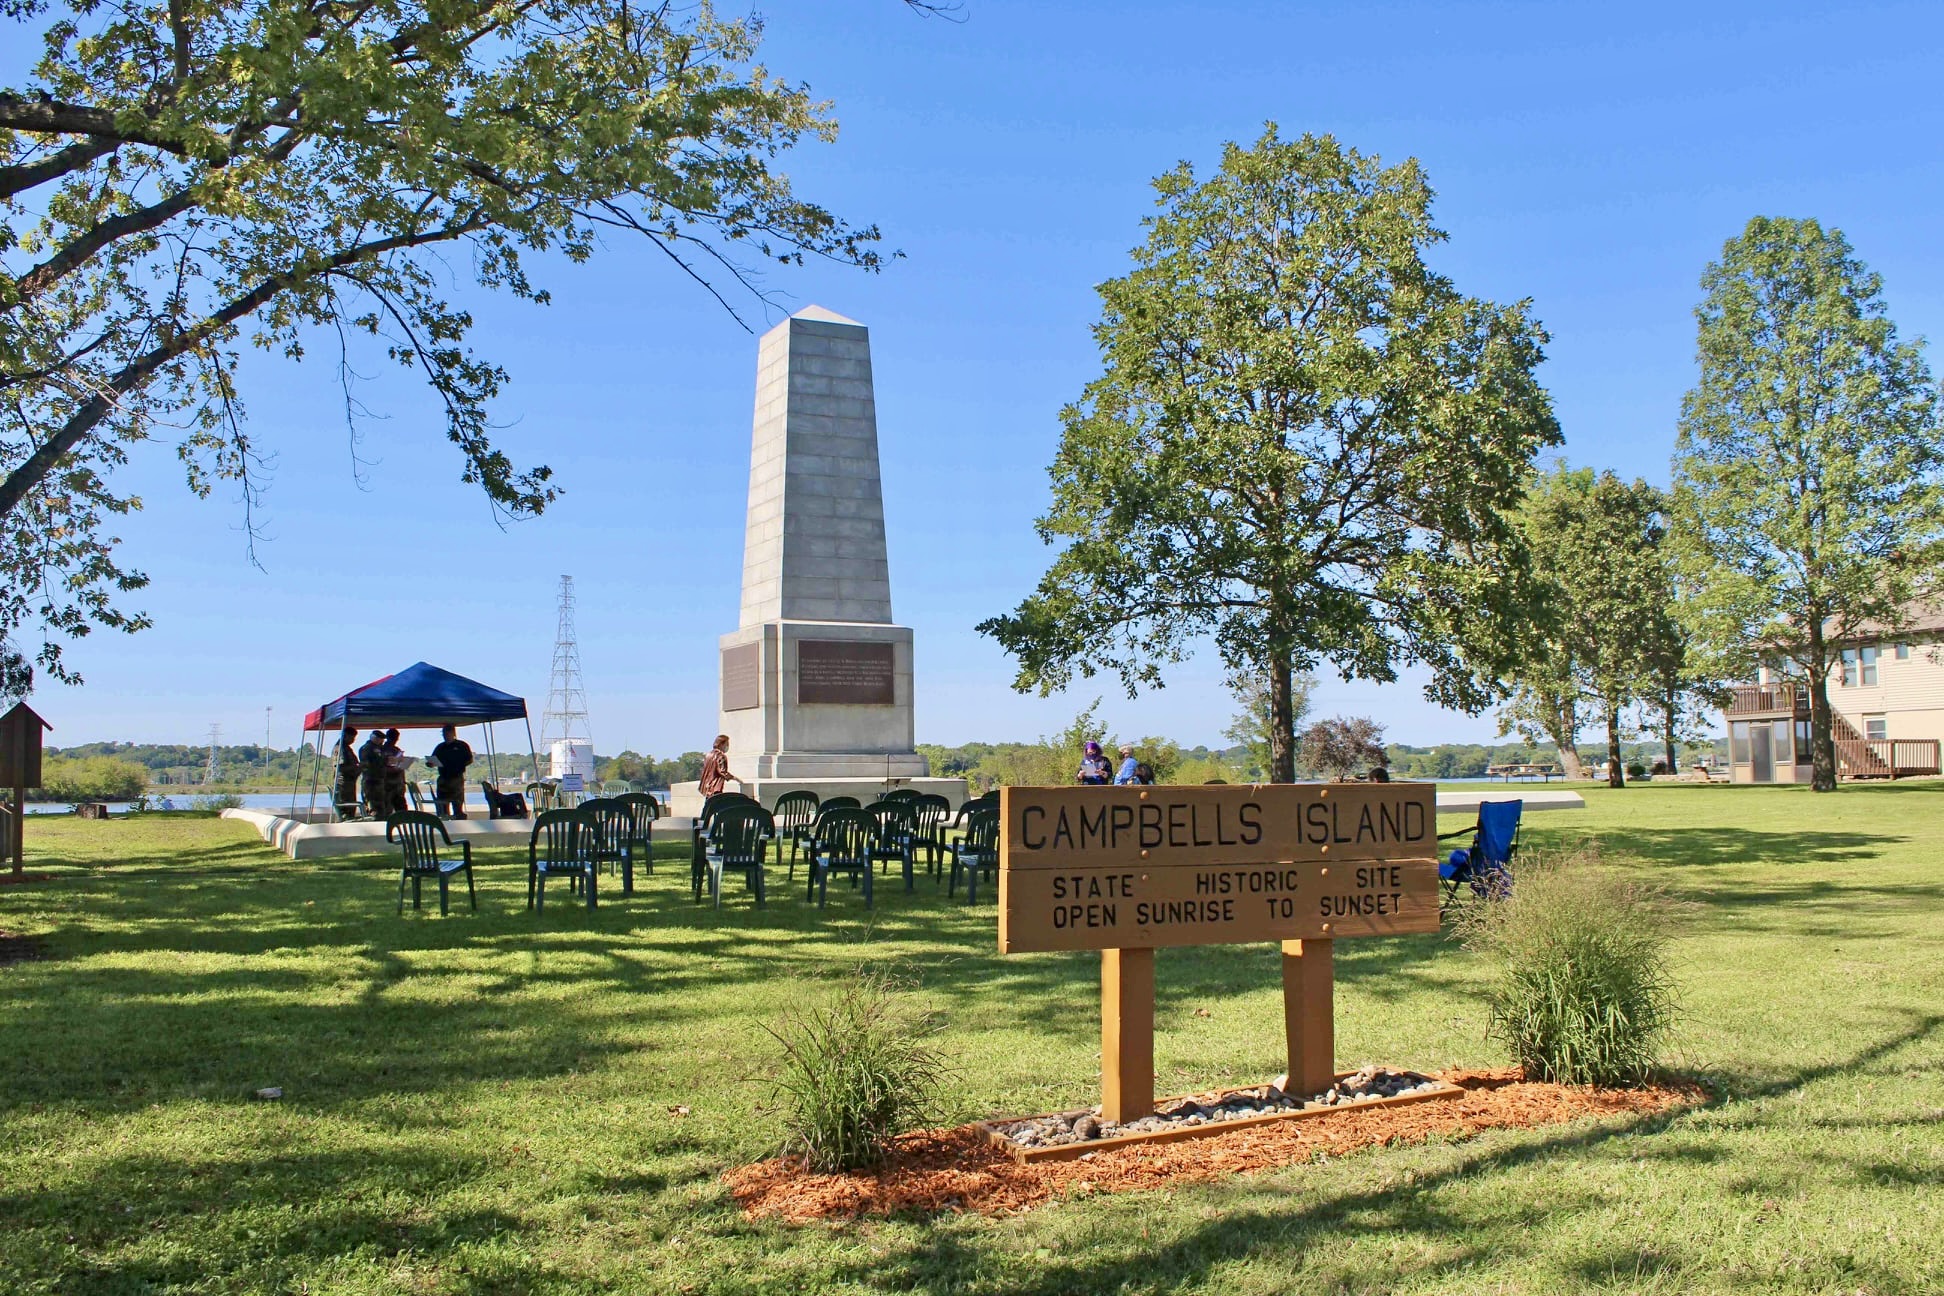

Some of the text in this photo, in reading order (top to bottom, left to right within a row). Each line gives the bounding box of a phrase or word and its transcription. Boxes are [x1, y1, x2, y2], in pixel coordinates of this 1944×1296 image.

[1021, 801, 1426, 851] CAMPBELLS ISLAND
[1053, 866, 1401, 899] STATE HISTORIC SITE
[1053, 894, 1401, 929] OPEN SUNRISE TO SUNSET
